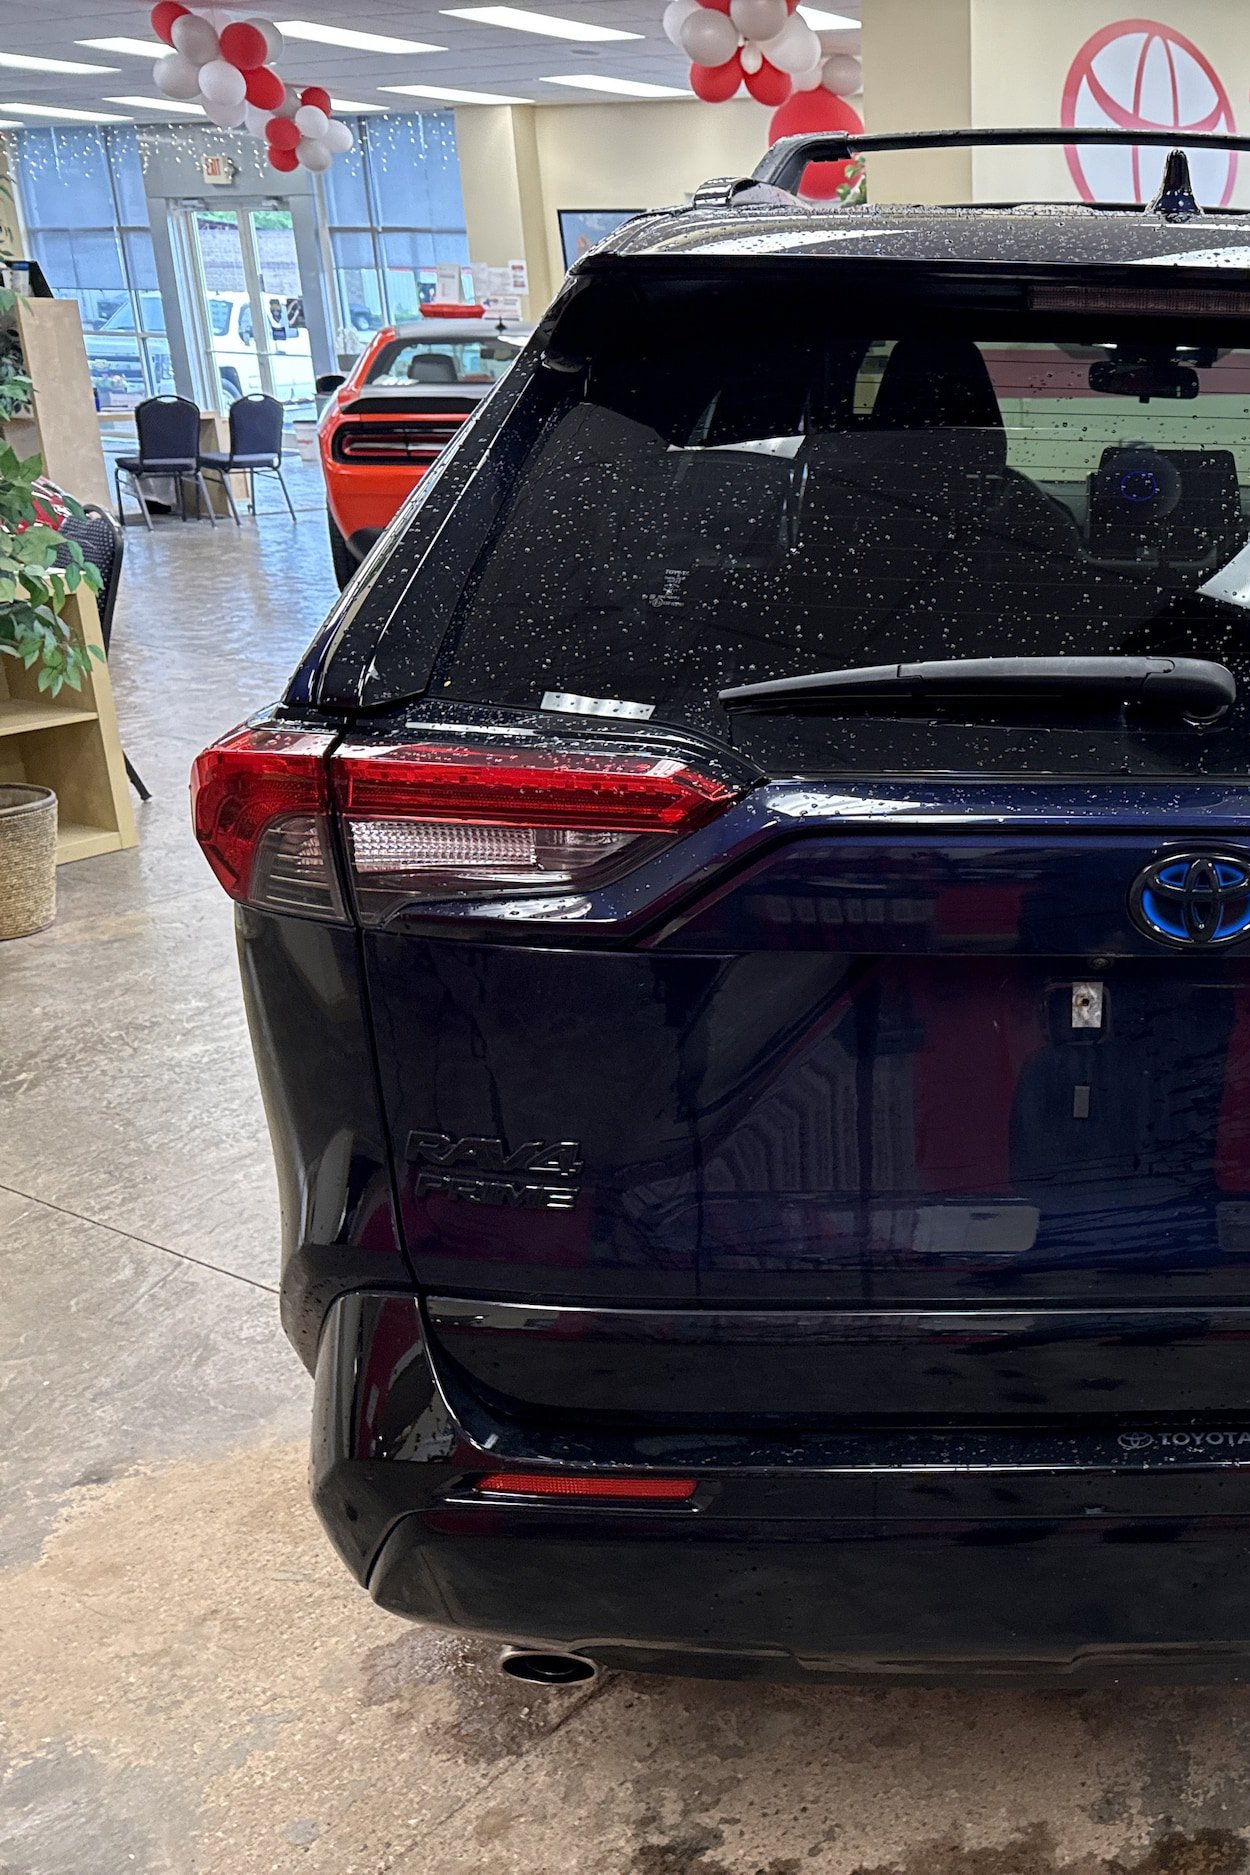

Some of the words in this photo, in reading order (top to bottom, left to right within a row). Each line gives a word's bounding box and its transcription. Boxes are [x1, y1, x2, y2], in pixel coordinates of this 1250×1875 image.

[205, 157, 221, 177] EXIT
[404, 1130, 583, 1177] RAV4
[414, 1173, 580, 1209] PRIME
